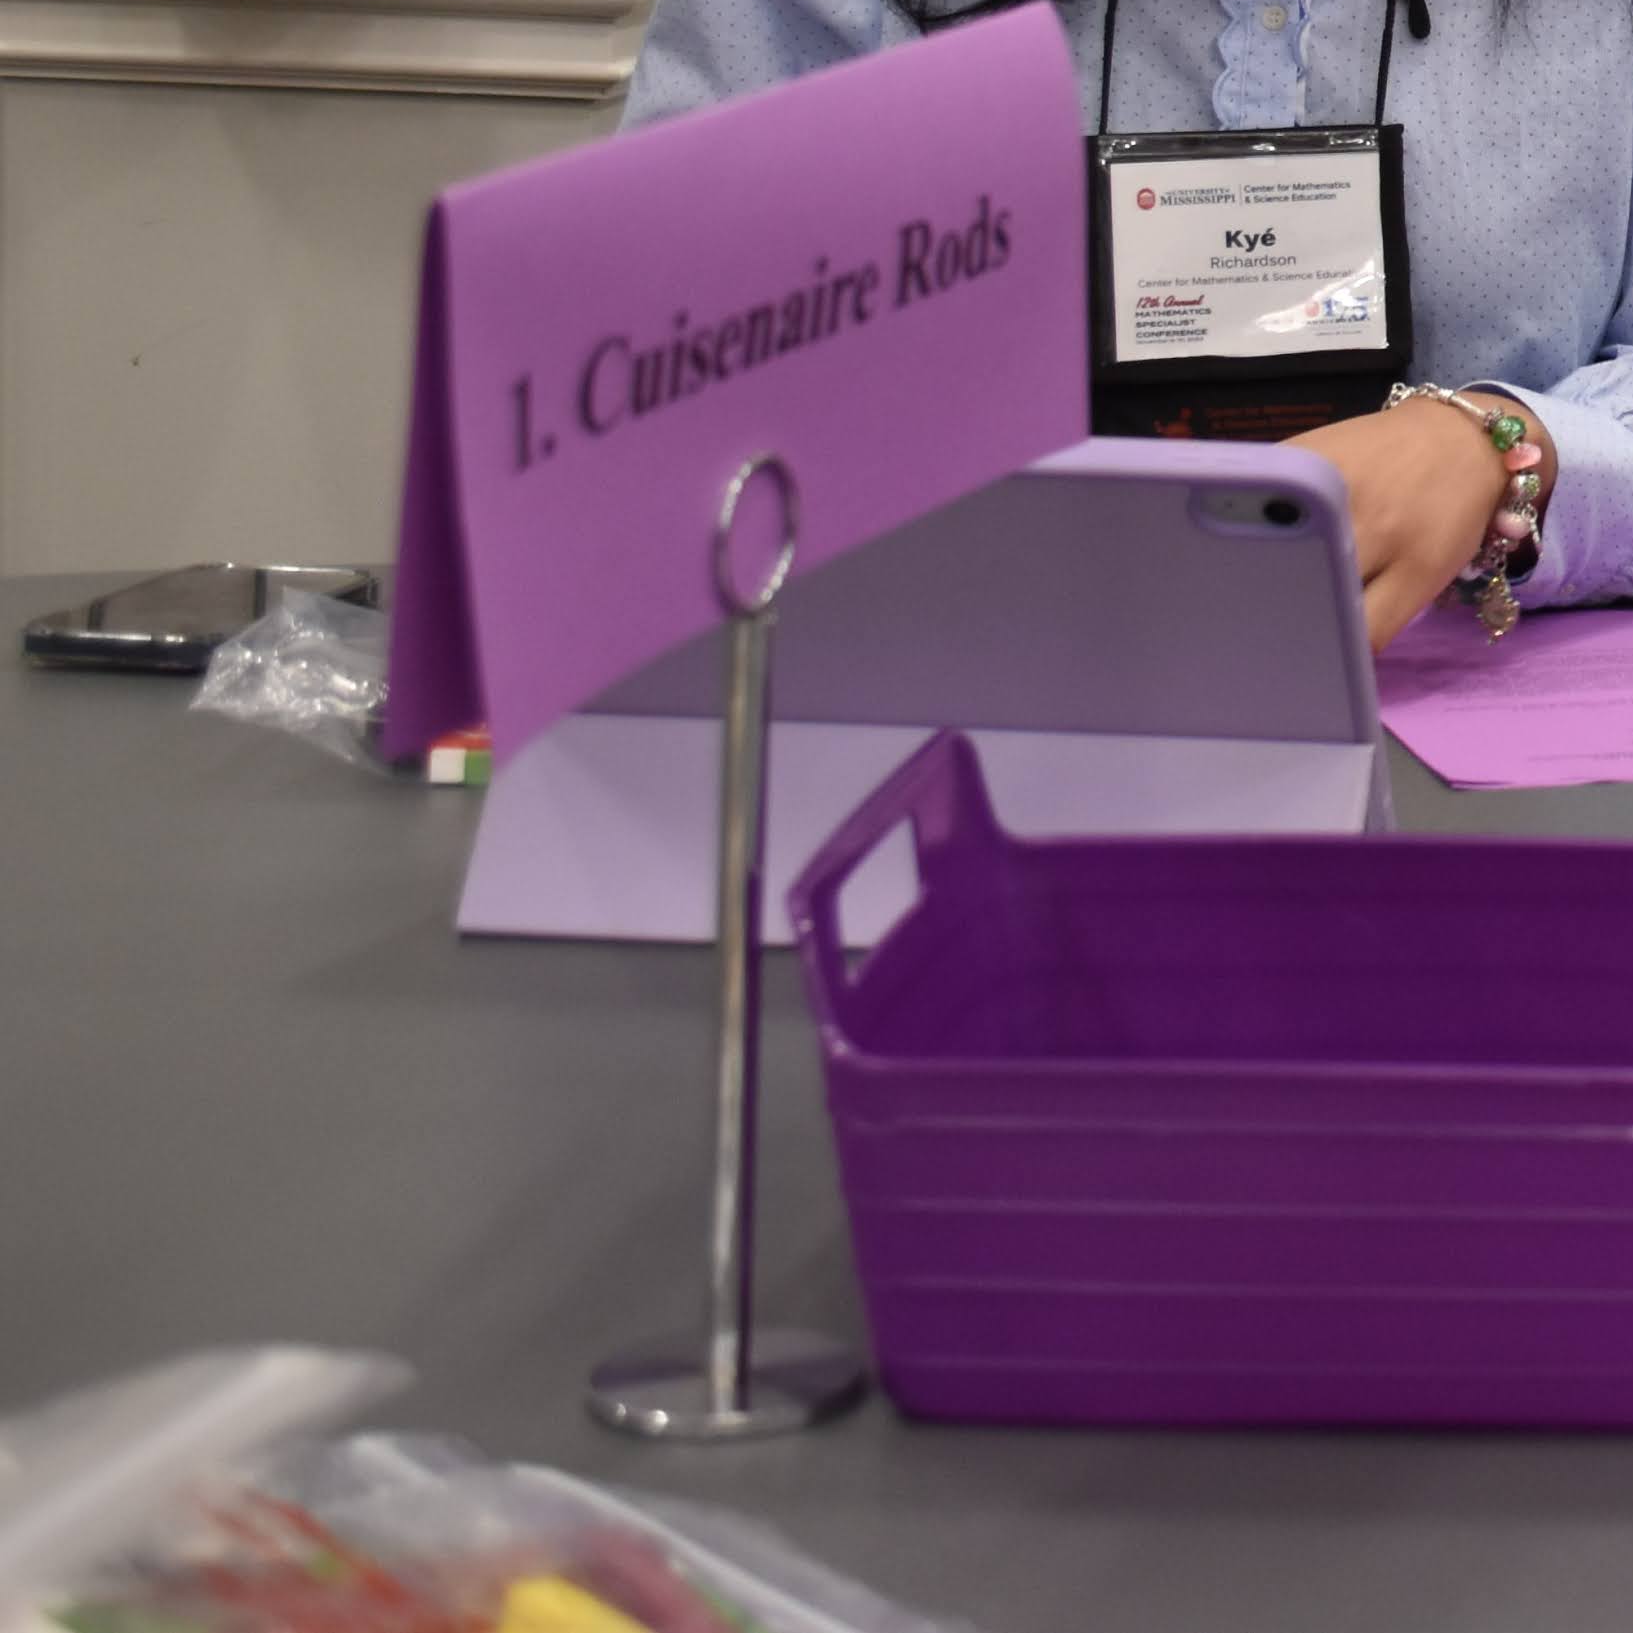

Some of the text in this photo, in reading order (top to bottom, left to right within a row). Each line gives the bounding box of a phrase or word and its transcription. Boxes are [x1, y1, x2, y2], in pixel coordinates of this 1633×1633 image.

[1243, 180, 1351, 193] Center for Mathematics
[1160, 194, 1236, 207] MISSISSIPPI
[1253, 194, 1289, 203] Science
[1291, 192, 1337, 202] Education
[1225, 227, 1277, 253] Kyé
[1210, 254, 1297, 270] Richardson
[1138, 279, 1173, 288] Center
[1174, 277, 1189, 287] for
[1191, 274, 1260, 286] Mathematics
[1262, 273, 1270, 282] &
[1272, 271, 1313, 282] Science
[1162, 294, 1205, 307] Annual
[1135, 307, 1212, 318] MATHEMATICS
[1136, 318, 1195, 329] SPECIALIST
[510, 194, 1014, 472] 1. Cuisenaire Rods
[1136, 327, 1208, 339] CONFERENCE
